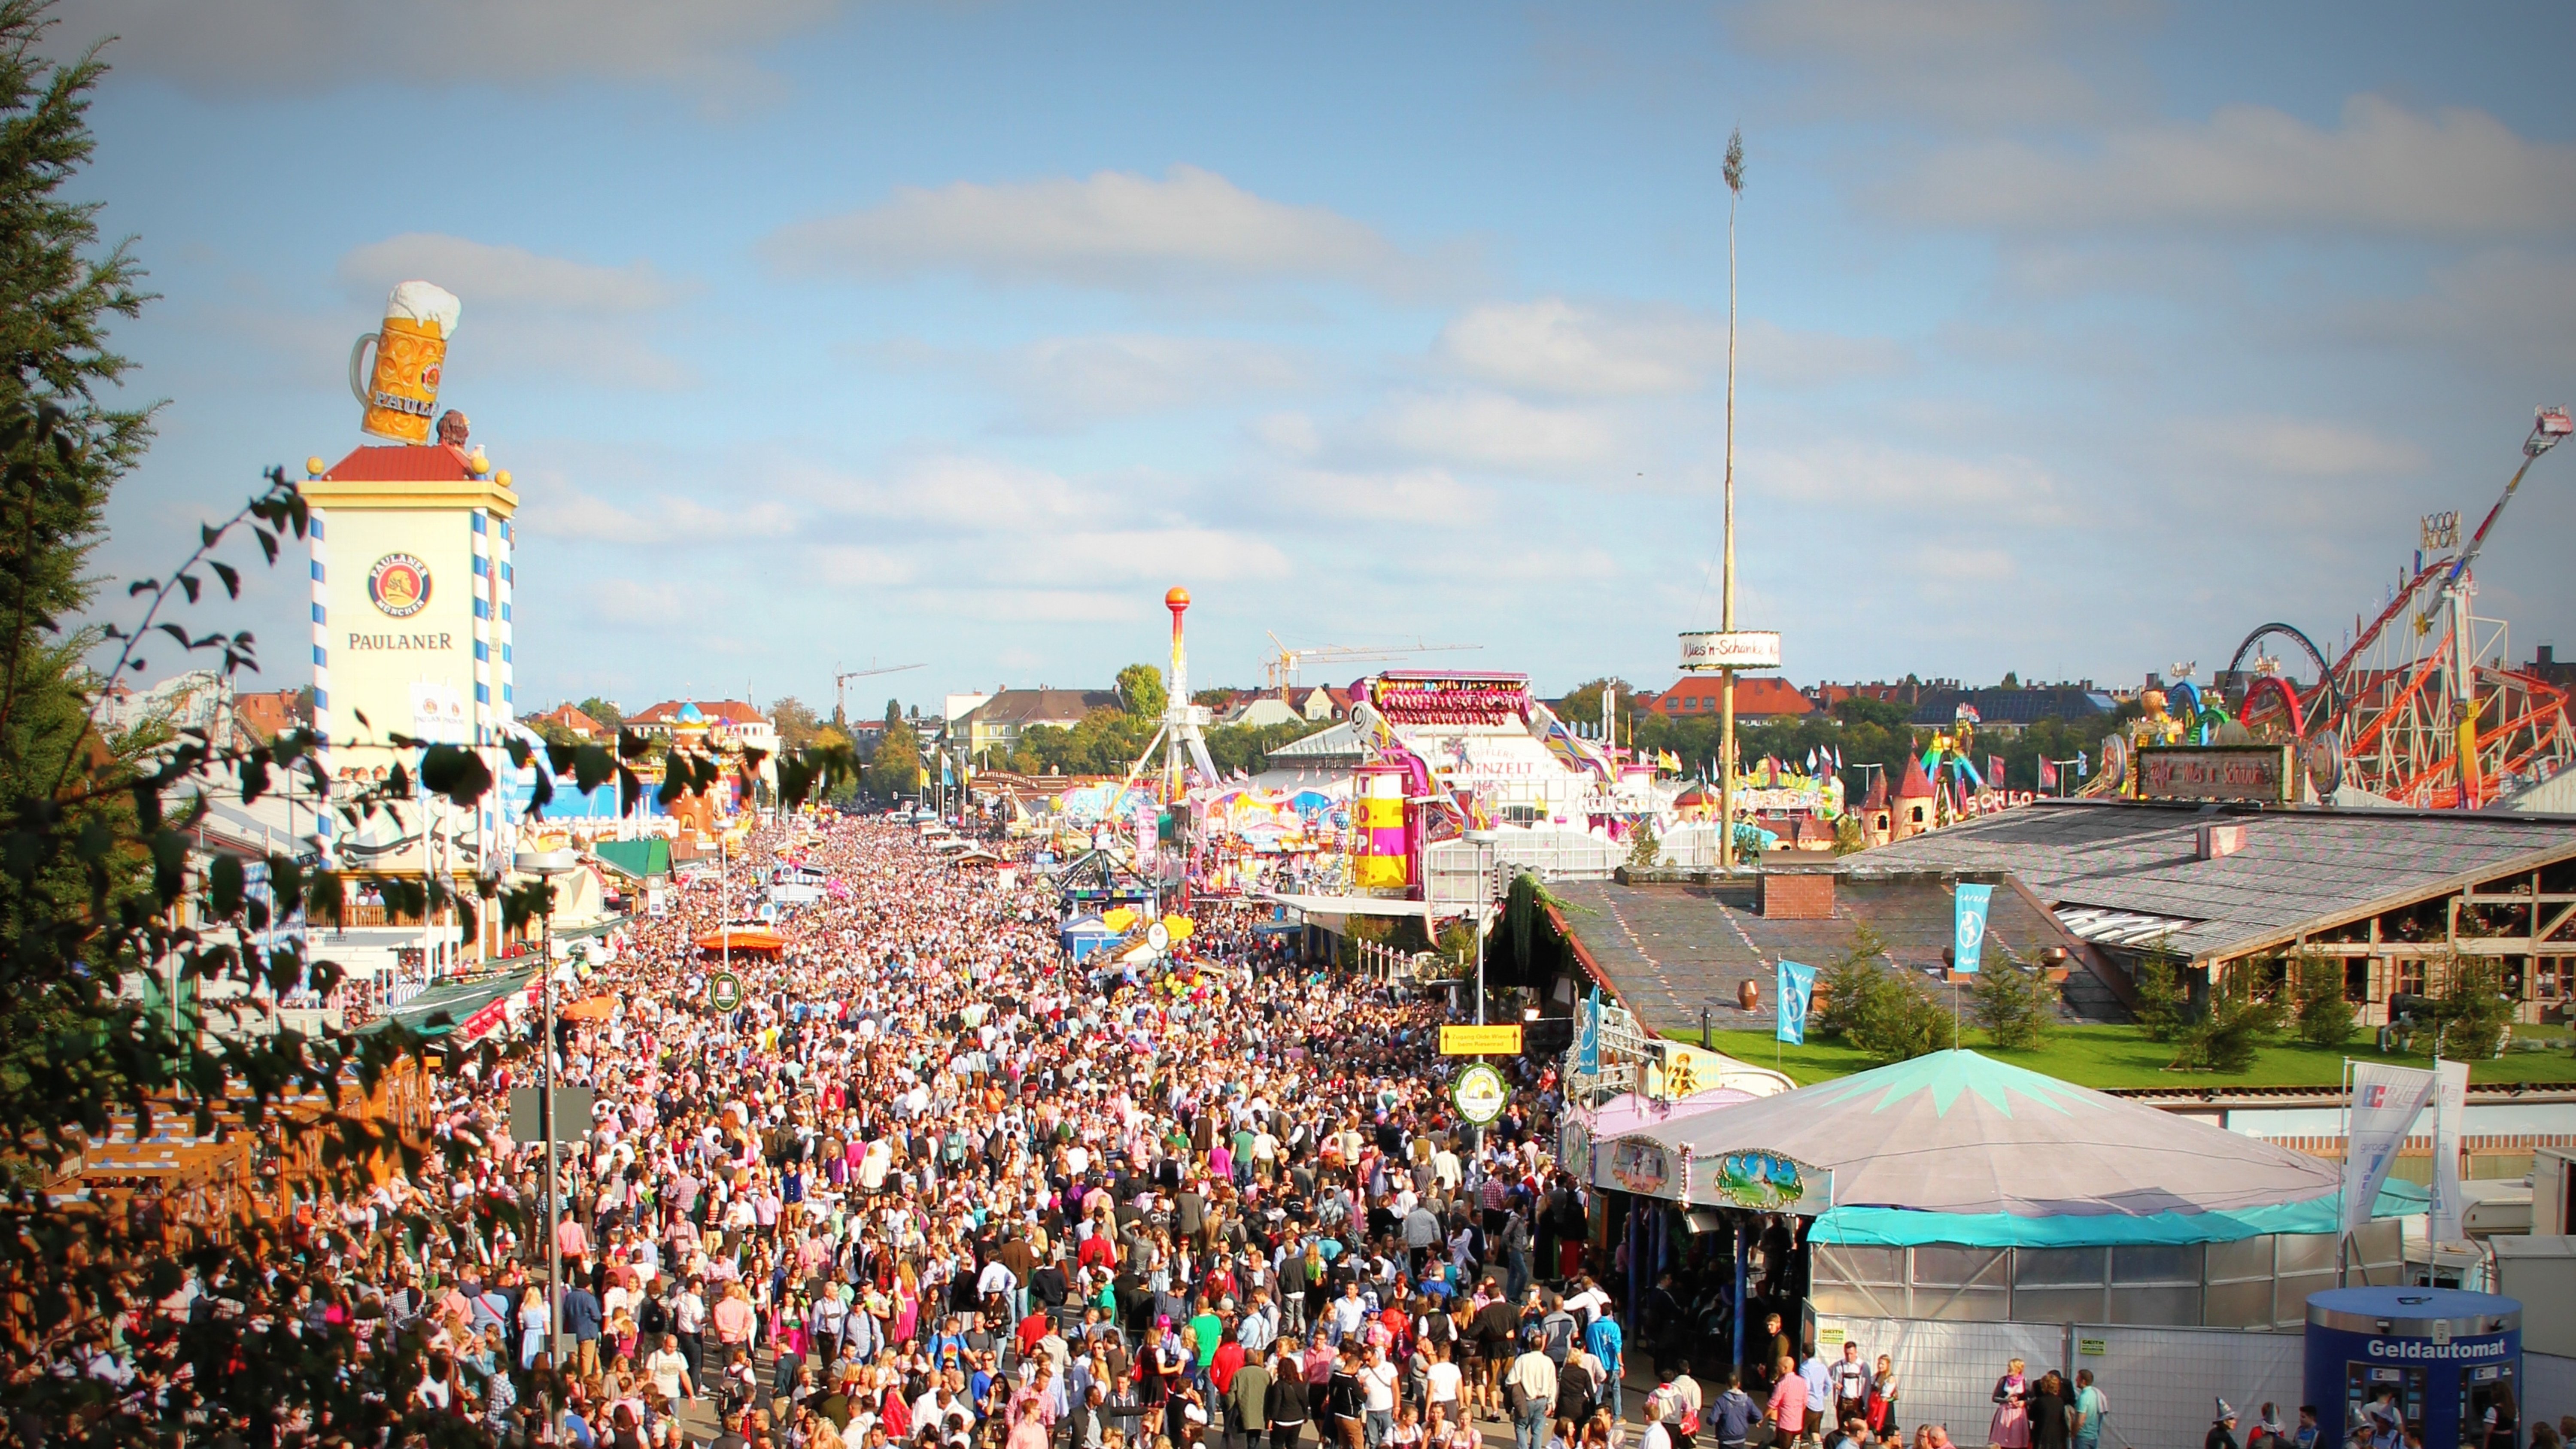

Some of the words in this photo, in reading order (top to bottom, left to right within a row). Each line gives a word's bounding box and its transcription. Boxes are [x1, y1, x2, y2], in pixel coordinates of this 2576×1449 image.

[370, 554, 428, 578] PAULANER
[348, 633, 452, 650] PAULANER
[1966, 790, 2048, 812] SCHLO
[2368, 1338, 2505, 1359] Geldautomat
